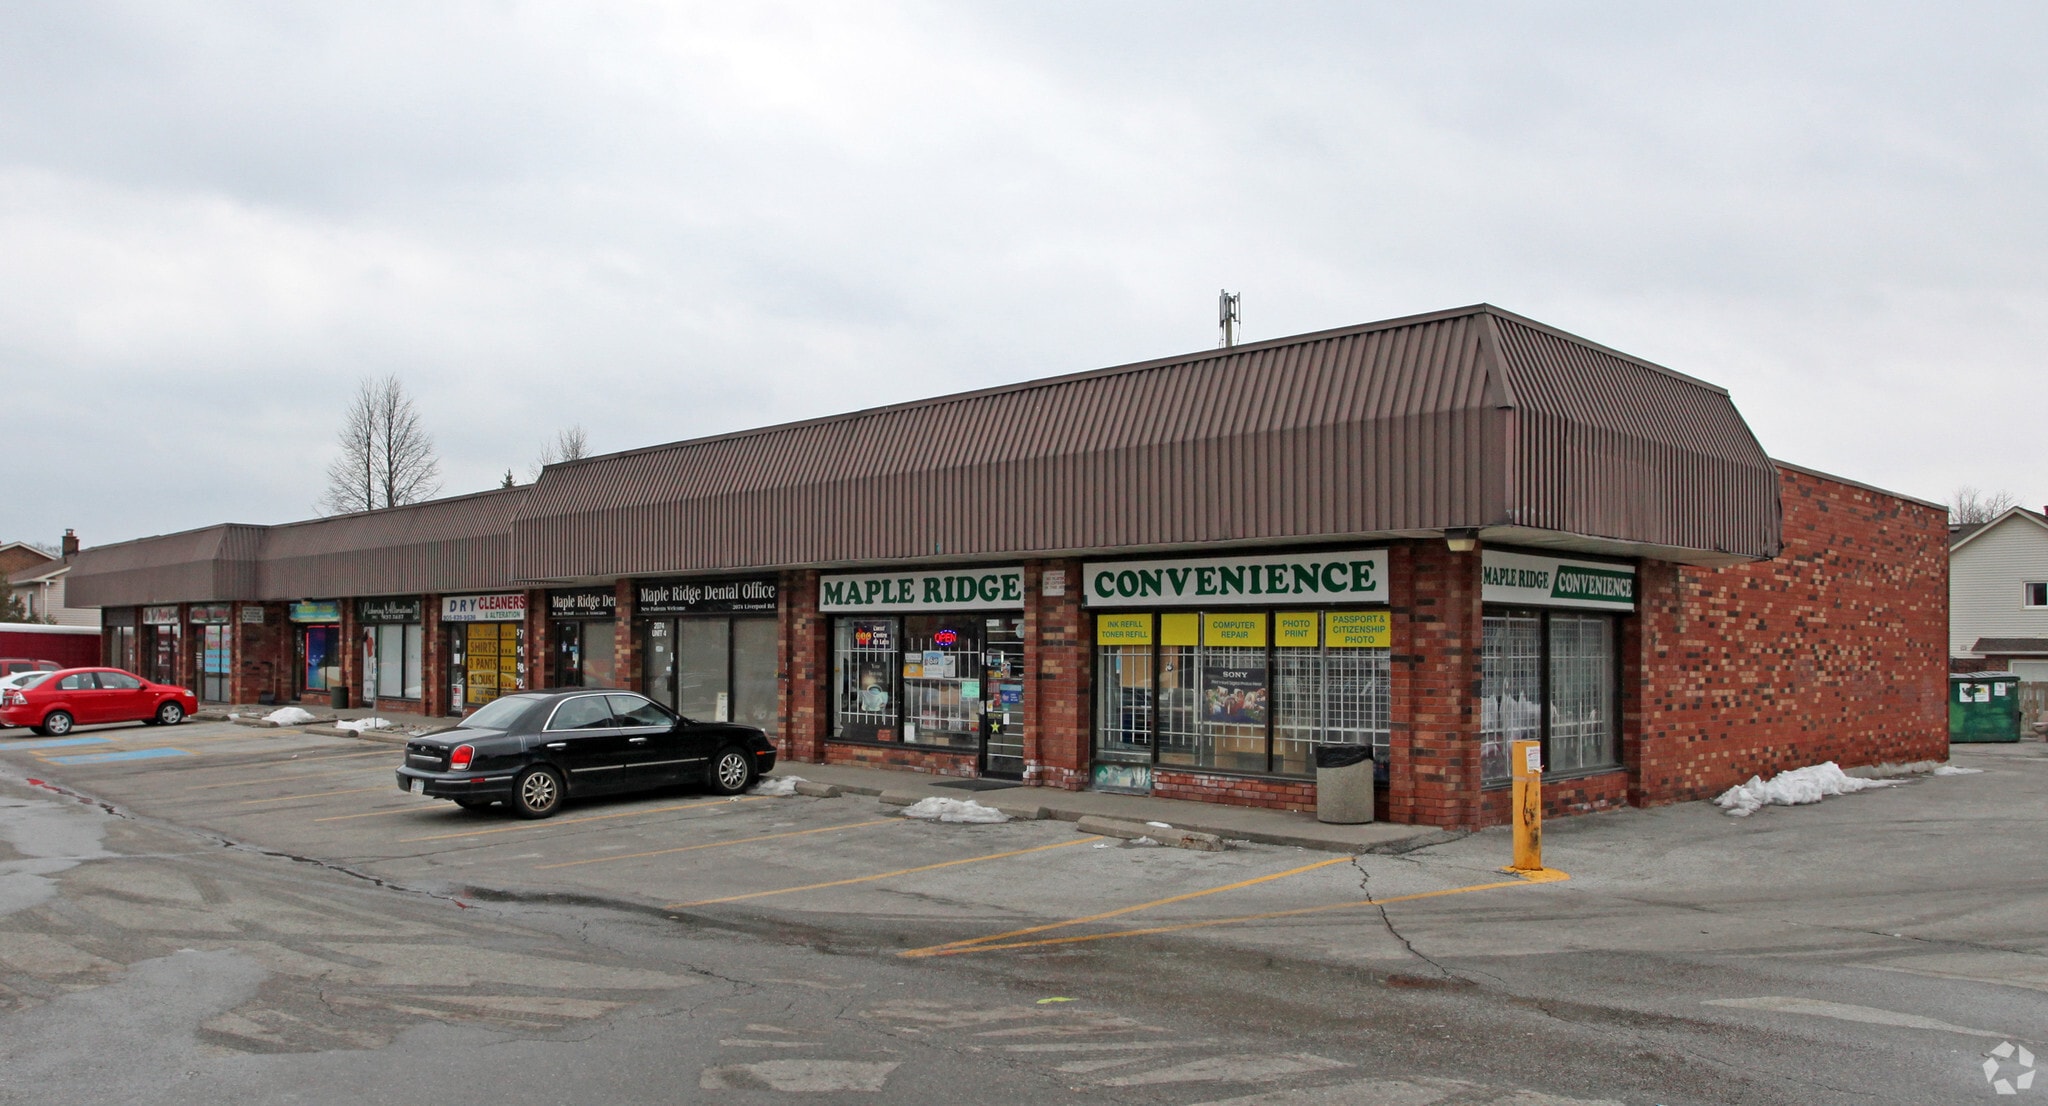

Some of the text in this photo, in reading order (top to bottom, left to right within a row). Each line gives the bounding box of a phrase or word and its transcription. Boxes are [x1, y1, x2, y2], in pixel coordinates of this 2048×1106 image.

[1094, 560, 1377, 598] CONVENIENCE
[1483, 566, 1632, 597] MAPLE RIDGE CONVENIENCE
[640, 582, 776, 605] Maple Ridge Dental Office
[823, 578, 915, 605] MAPLE
[923, 574, 1022, 603] RIDGE
[478, 595, 525, 610] CLEANERS
[552, 595, 576, 610] Maple
[577, 594, 600, 610] Ridge
[489, 611, 521, 619] ALTERATION
[1332, 615, 1385, 623] PASSPORT &
[1212, 621, 1255, 629] COMPUTER
[1332, 626, 1386, 634] CITIZENSHIP
[651, 629, 662, 637] UNIT
[934, 632, 957, 643] OPEN
[1125, 630, 1148, 638] REFILL
[470, 642, 497, 653] SHIRTS
[476, 658, 497, 670] PANTS
[470, 674, 496, 686] BLOUSE
